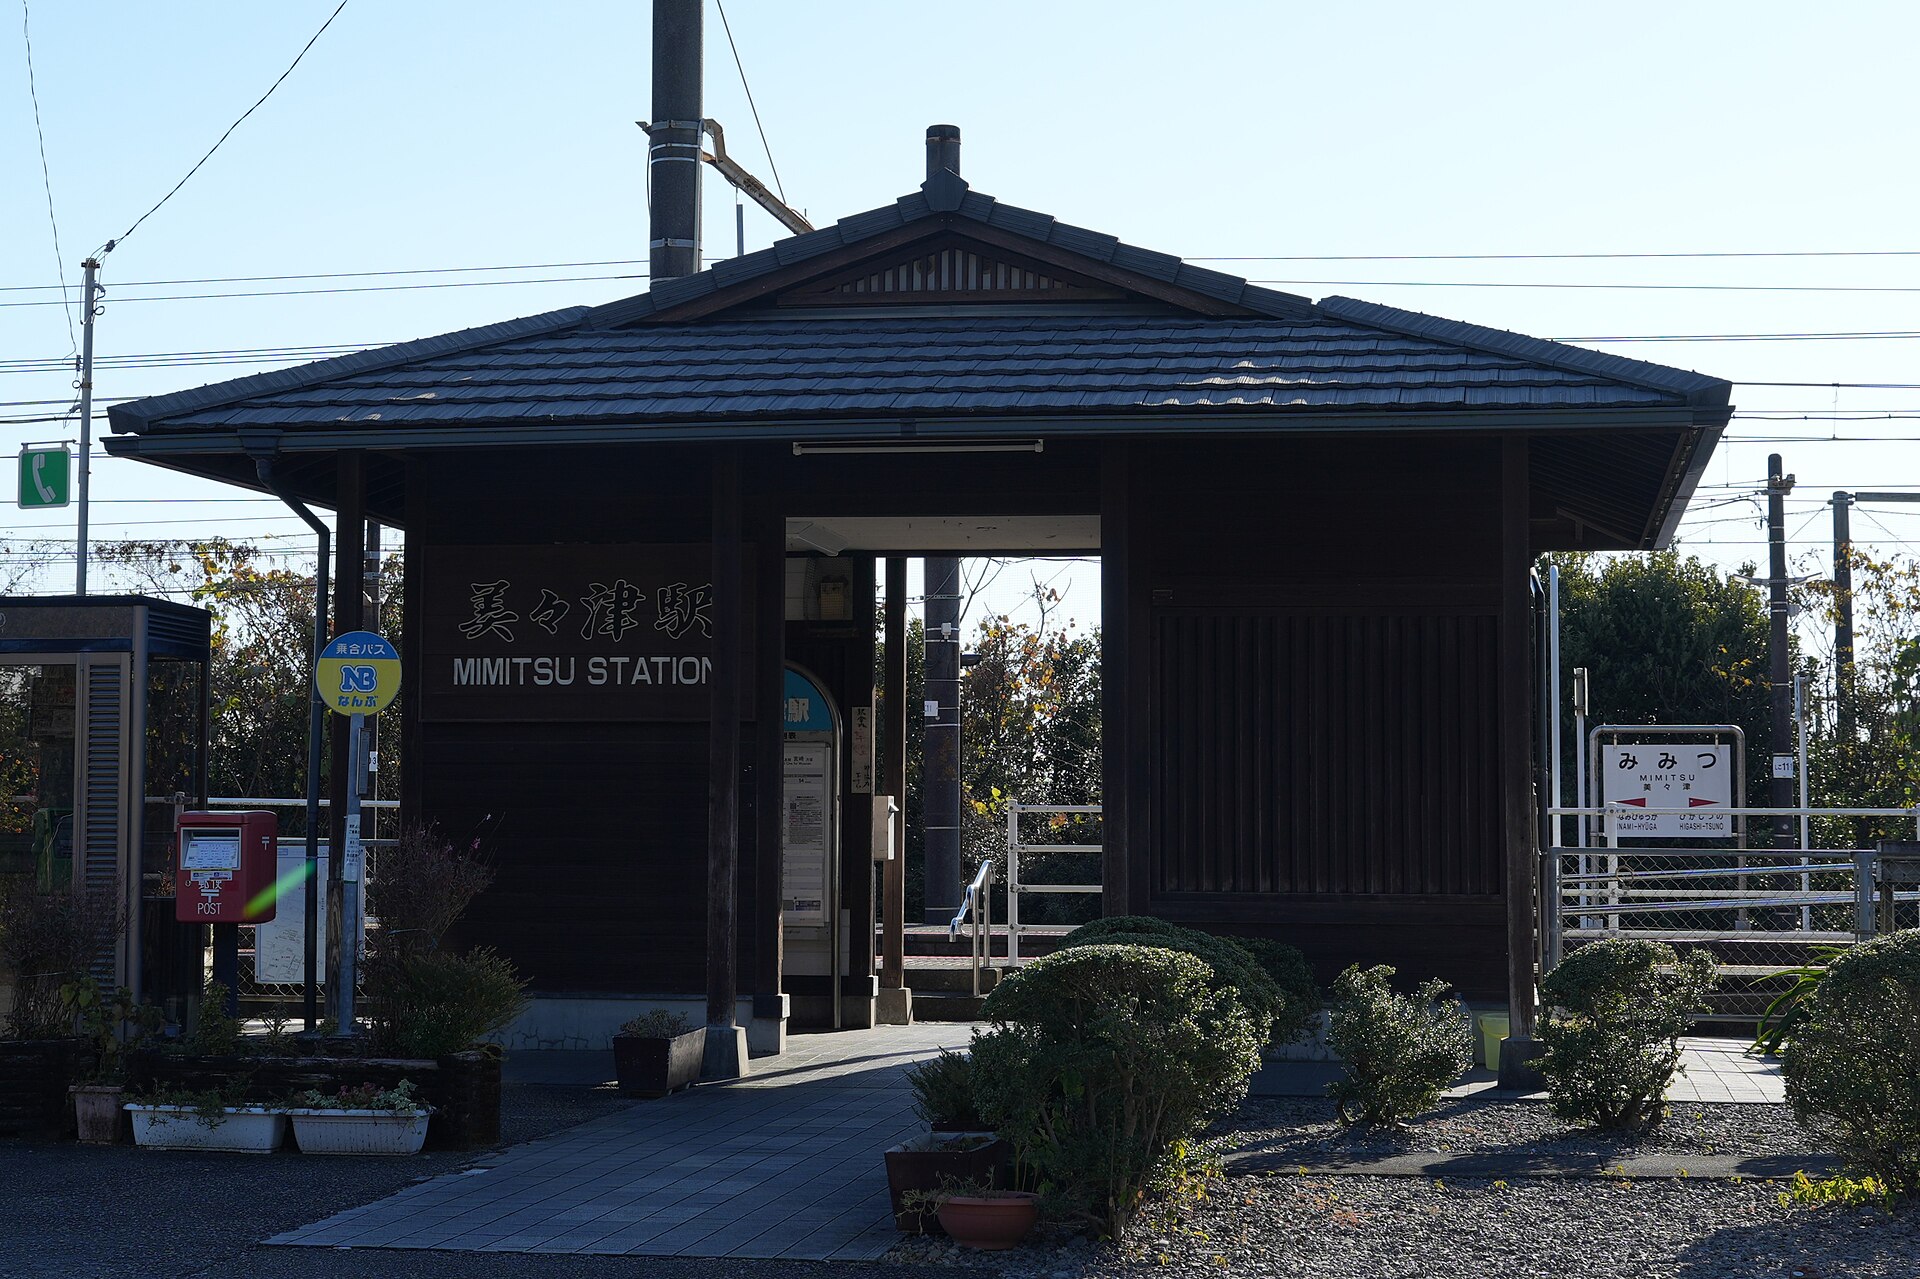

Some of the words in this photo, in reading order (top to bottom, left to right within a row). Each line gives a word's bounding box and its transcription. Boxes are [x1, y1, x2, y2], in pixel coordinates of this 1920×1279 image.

[458, 579, 712, 642] 美々津駅
[336, 643, 386, 655] 乗合バス
[453, 657, 575, 686] MIMITSU
[338, 695, 379, 707] なんぶ
[783, 697, 810, 722] 駅
[1618, 752, 1717, 770] みみつ
[1639, 774, 1696, 782] MIMITSU
[1643, 783, 1691, 791] 美々津
[1679, 822, 1724, 831] HIGASHI-TSUNO
[197, 902, 222, 915] POST
